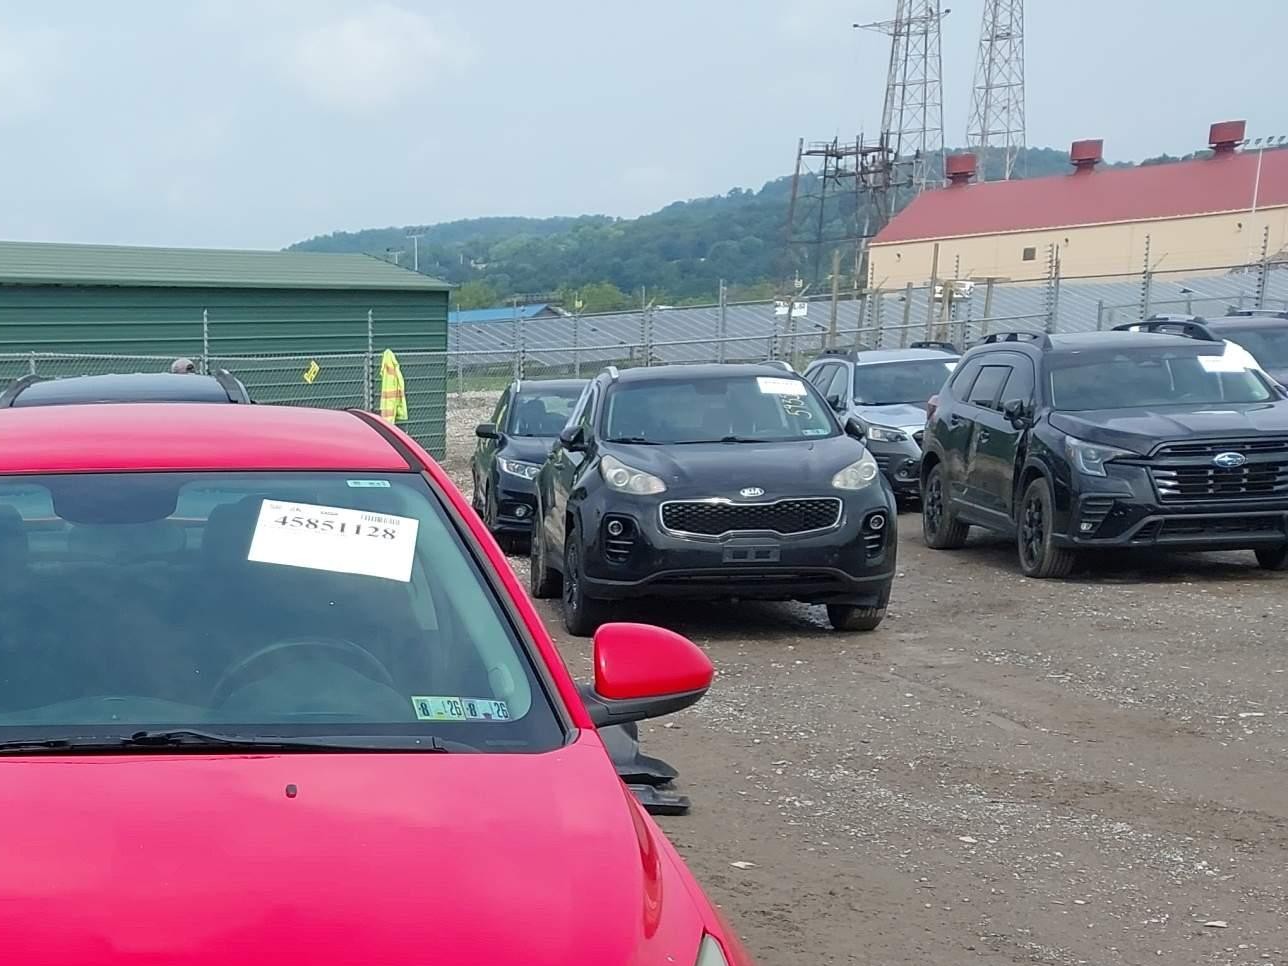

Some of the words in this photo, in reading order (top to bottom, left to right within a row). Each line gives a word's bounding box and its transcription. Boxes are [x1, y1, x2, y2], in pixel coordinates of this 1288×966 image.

[274, 515, 397, 540] 45851128
[447, 700, 462, 716] 26
[494, 702, 509, 719] 26
